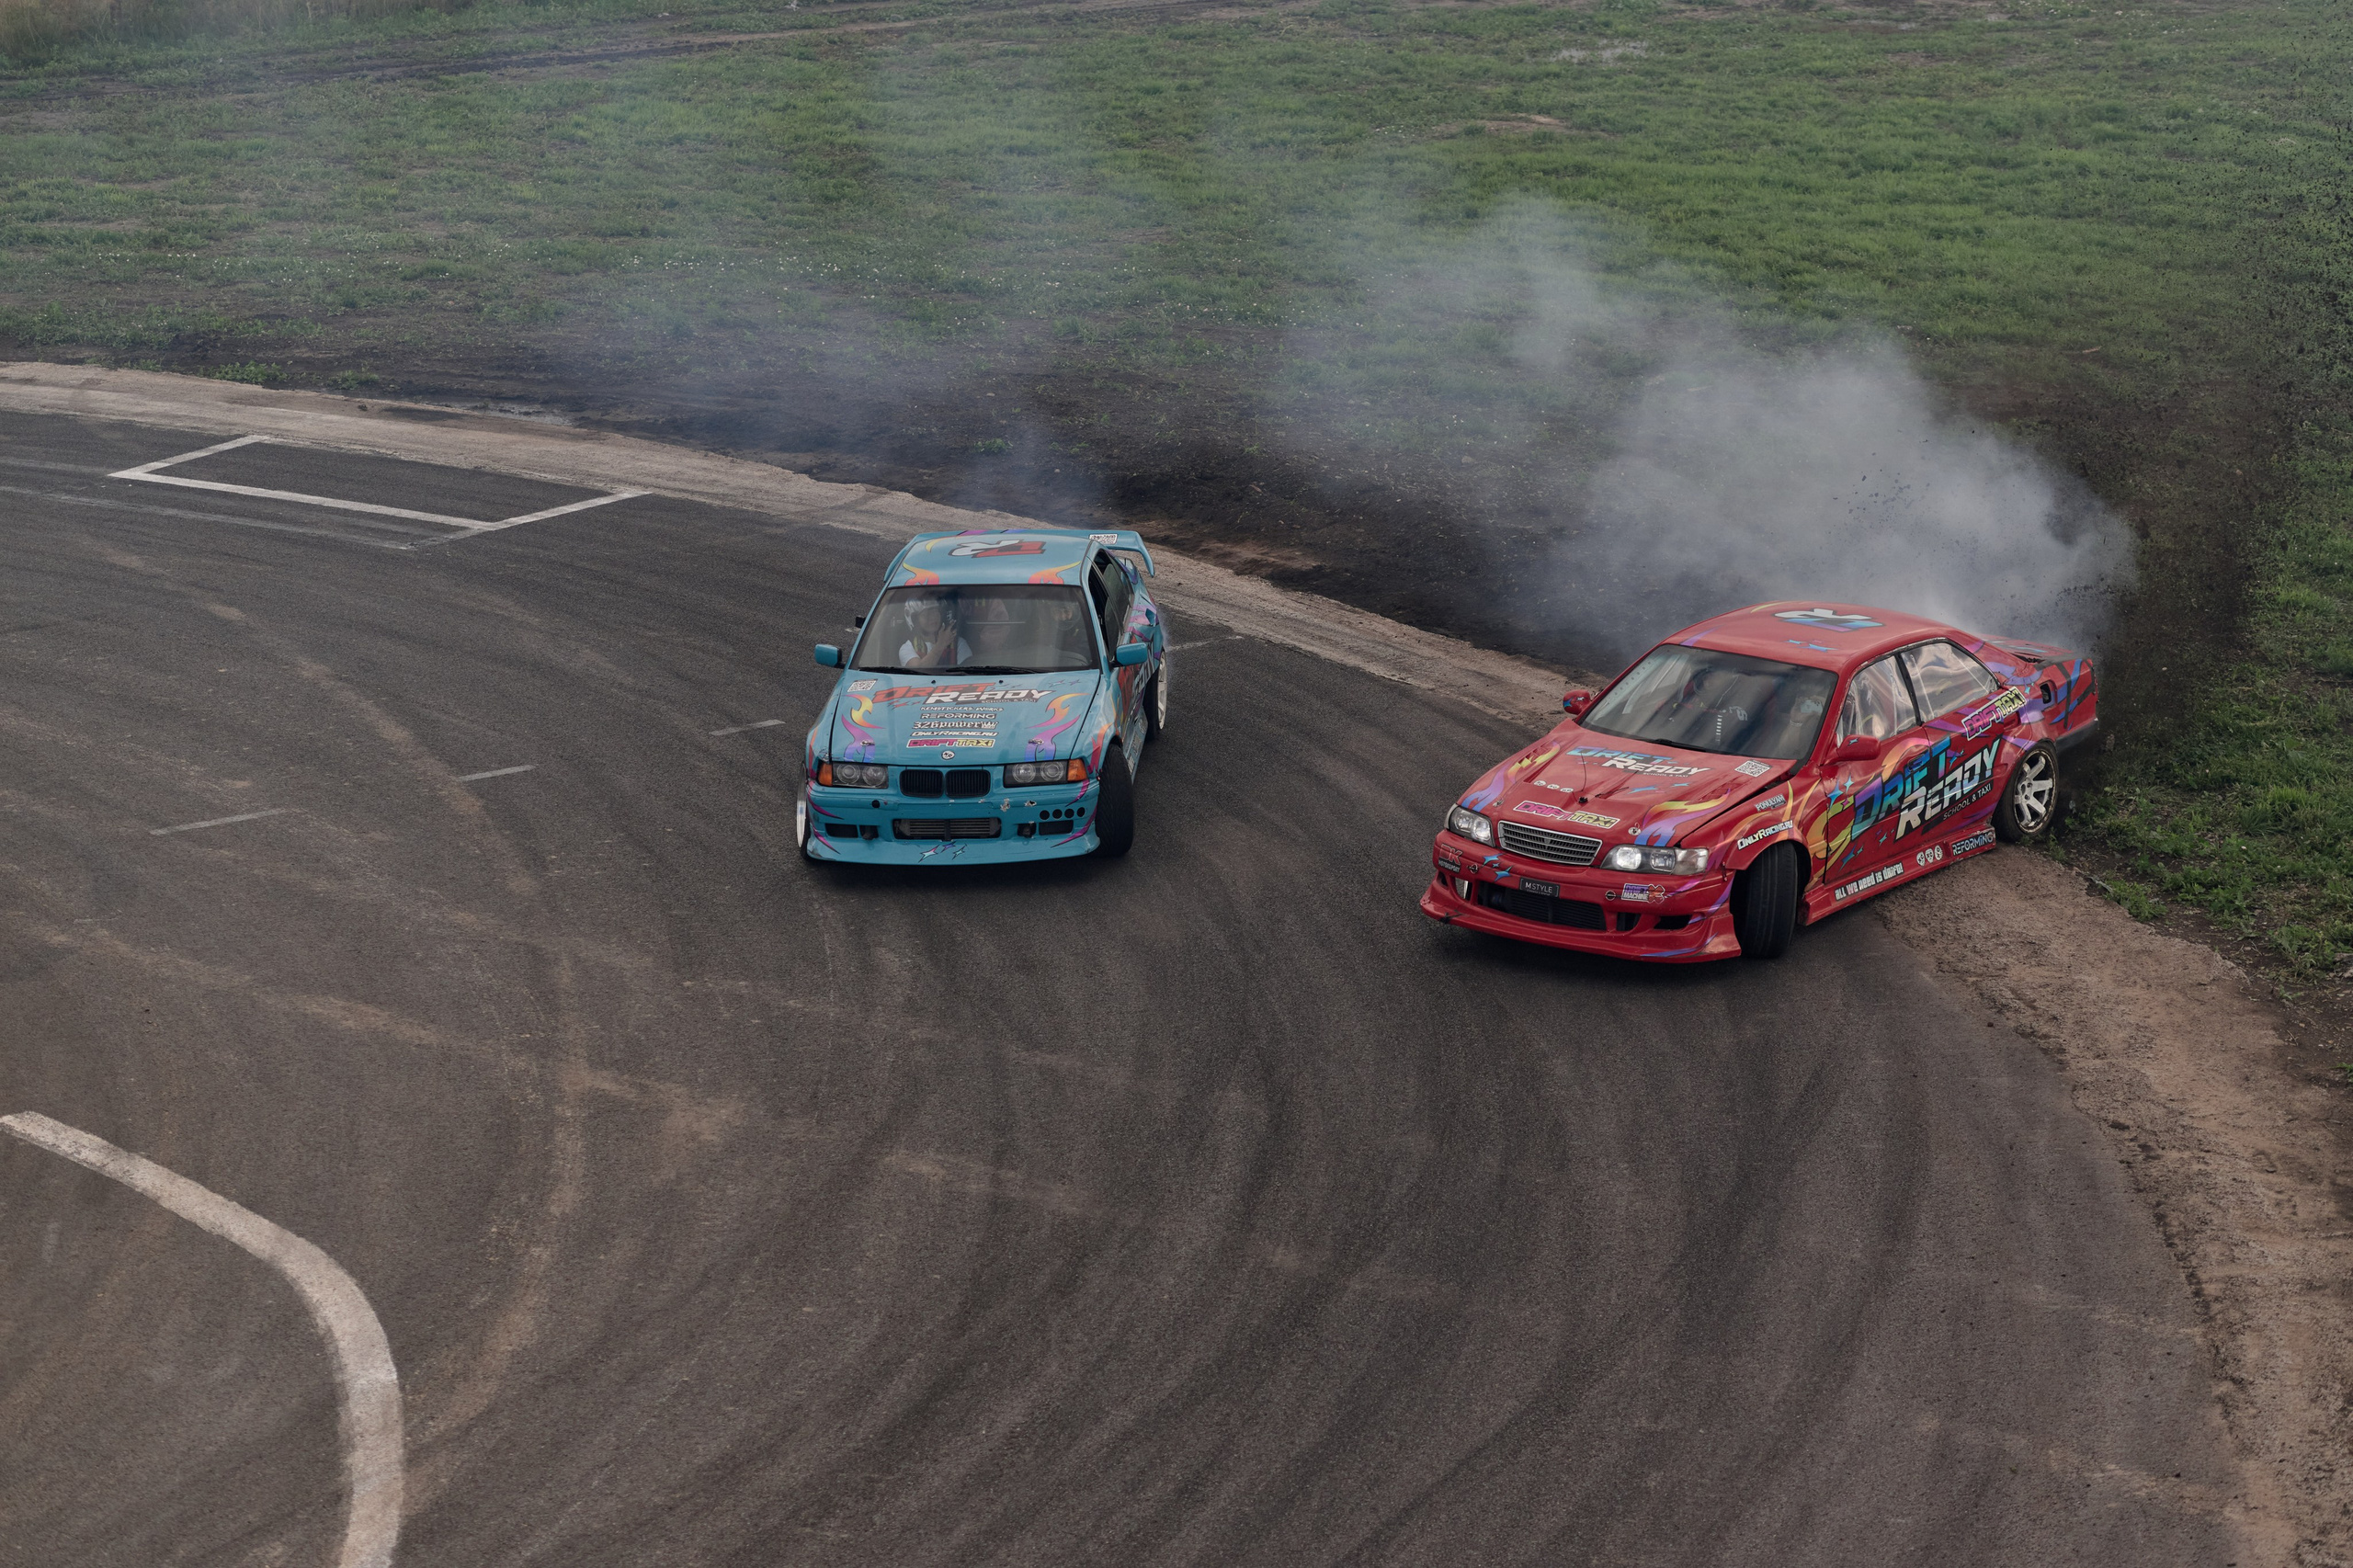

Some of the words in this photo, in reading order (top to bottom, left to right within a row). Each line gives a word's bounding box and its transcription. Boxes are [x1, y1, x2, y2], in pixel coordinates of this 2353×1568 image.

[872, 683, 996, 703] DRIFT
[925, 689, 1054, 704] READY
[913, 721, 982, 729] 326power
[1566, 745, 1673, 764] DRIFT
[1602, 756, 1711, 775] READY
[1851, 736, 1951, 841] DRIFT
[1895, 737, 2002, 841] READY
[1943, 798, 1971, 821] SCHOOL
[1972, 794, 1977, 803] &
[1977, 783, 1993, 800] TAXI
[1951, 832, 1994, 856] REFORMING
[1875, 871, 1883, 883] is
